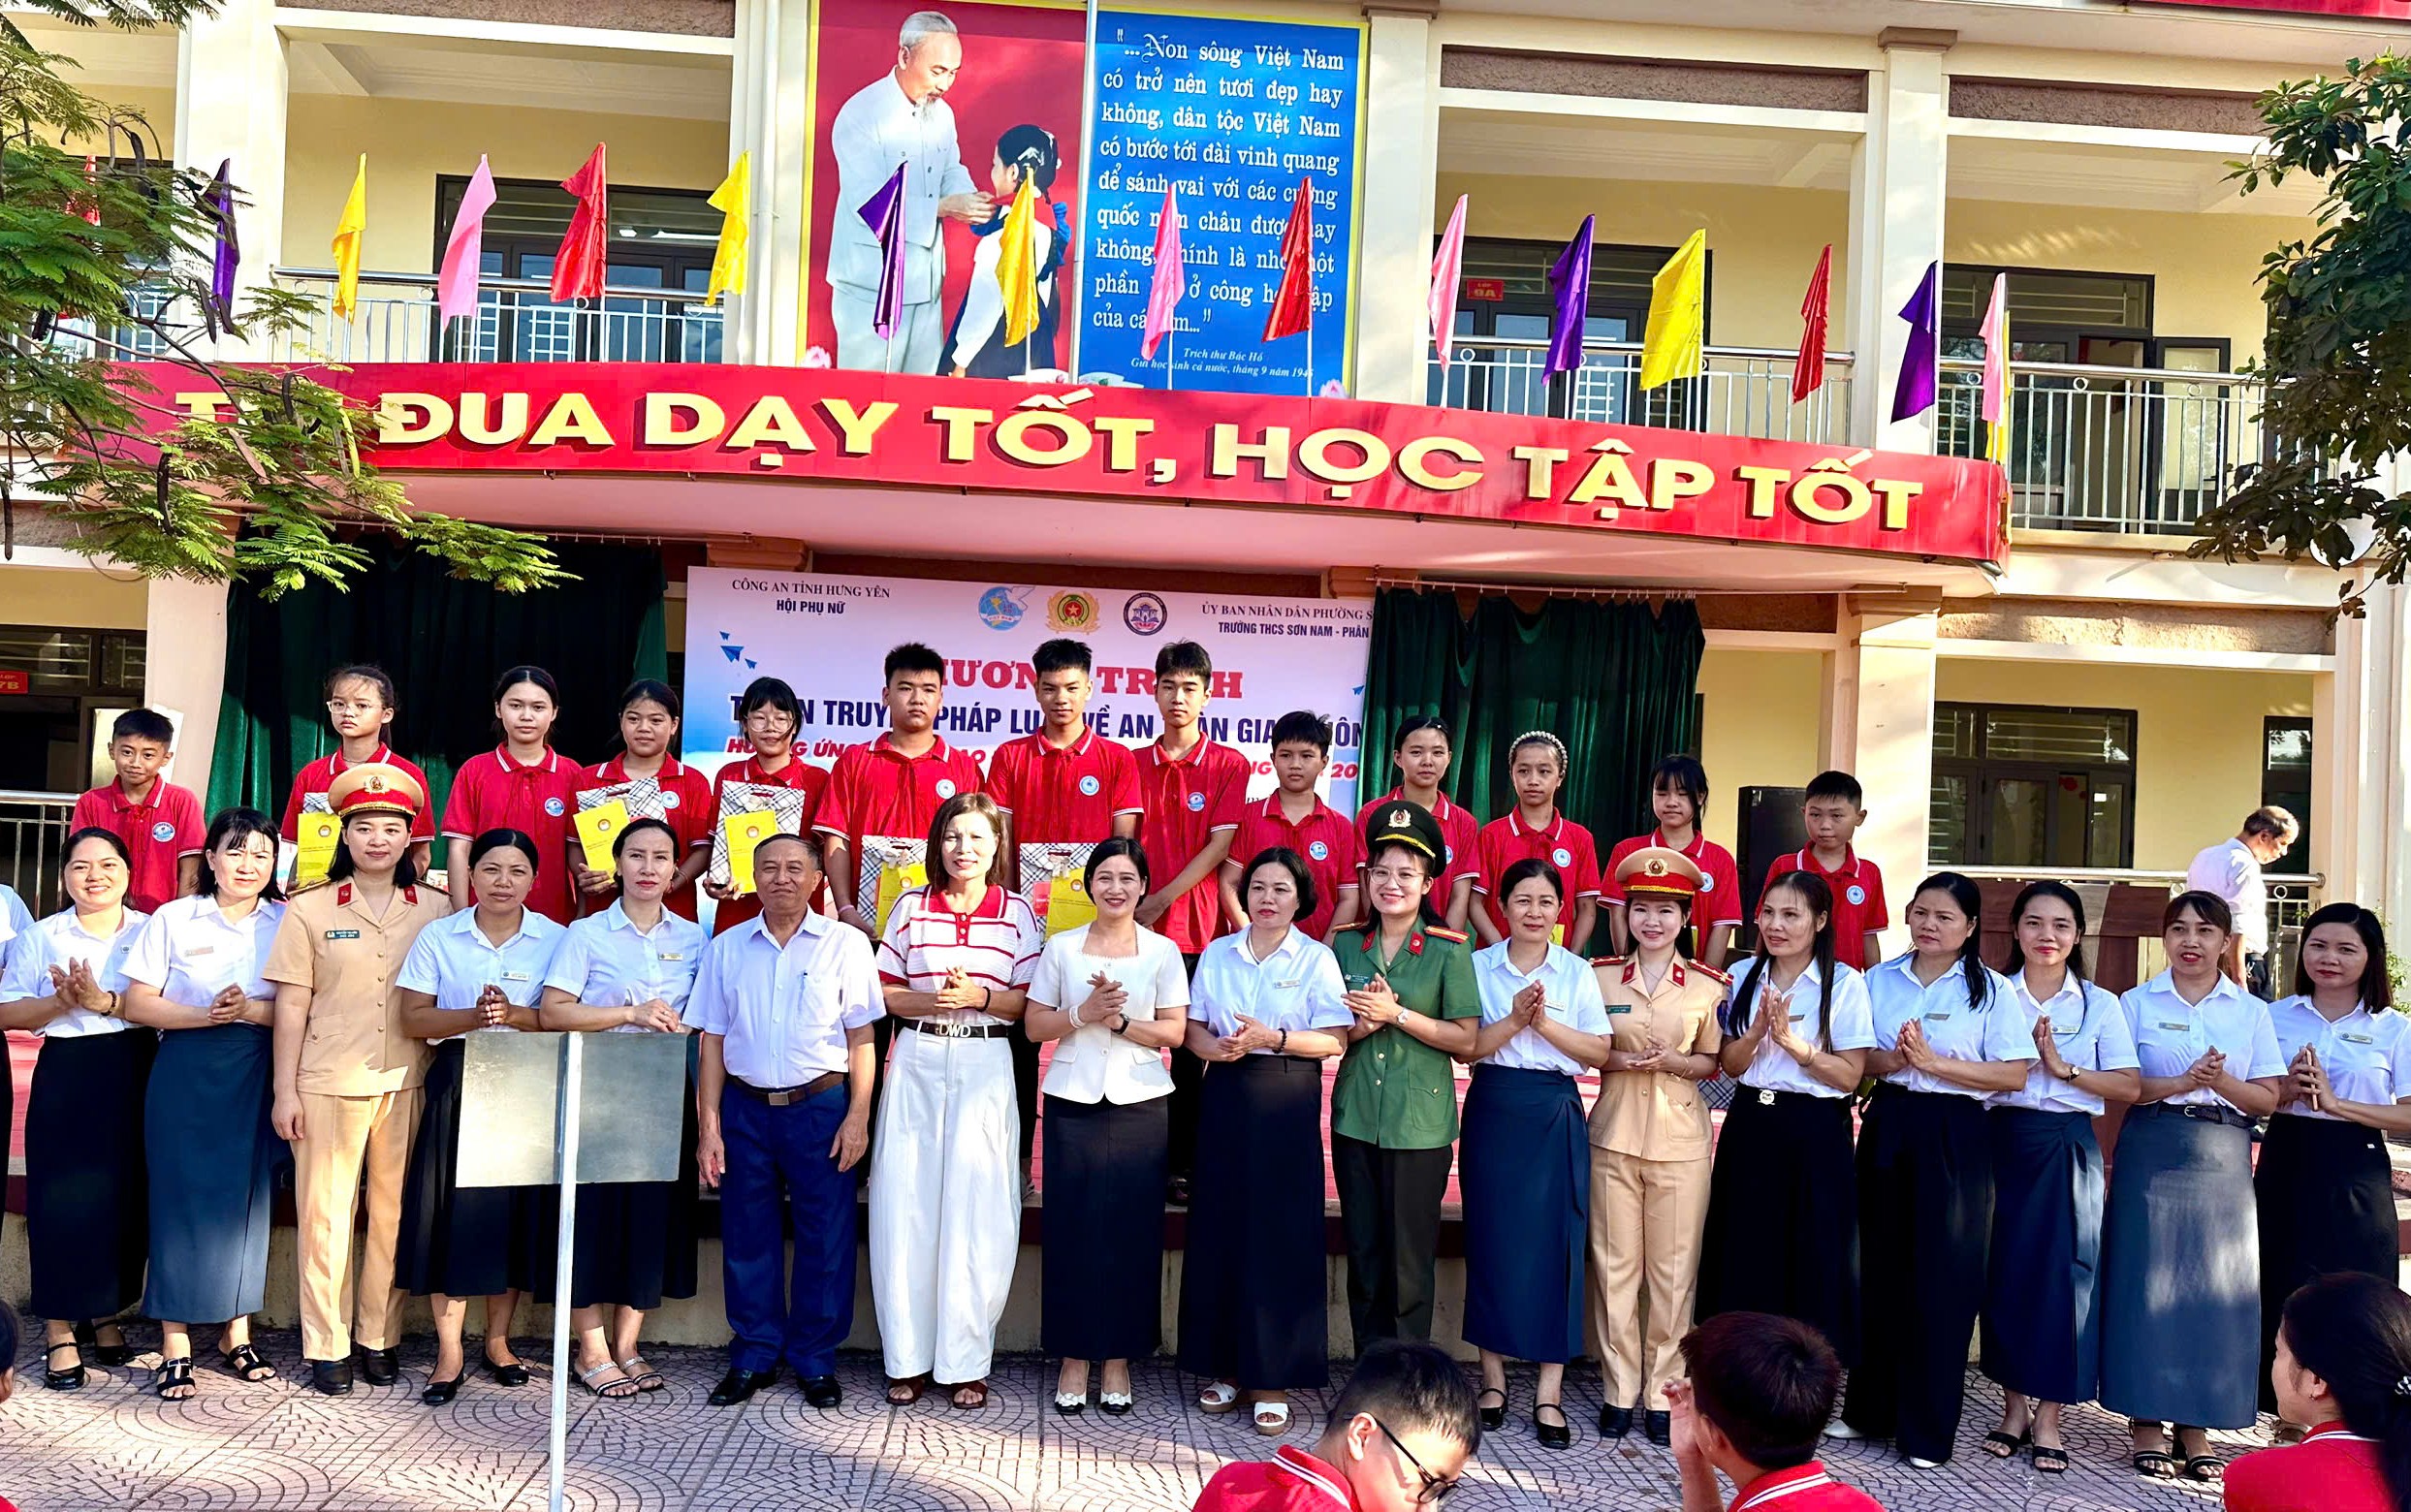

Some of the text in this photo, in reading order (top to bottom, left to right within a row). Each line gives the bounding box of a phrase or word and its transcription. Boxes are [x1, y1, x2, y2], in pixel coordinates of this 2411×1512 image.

[1199, 41, 1243, 69] sông
[1254, 45, 1292, 72] Việt
[1303, 48, 1345, 71] Nam
[1103, 67, 1344, 109] có trở nên tươi đẹp hay
[1101, 102, 1341, 139] không, dân tộc Việt Nam
[1100, 138, 1340, 176] có bước tới đài vinh quang
[1098, 163, 1122, 190] để
[1126, 171, 1169, 194] sánh
[1176, 175, 1204, 196] vai
[1213, 179, 1240, 199] với
[1247, 179, 1277, 202] các
[1096, 201, 1140, 230] quốc
[1150, 211, 1189, 230] nm
[1198, 210, 1241, 234] châu
[1311, 222, 1337, 244] ay
[1181, 242, 1219, 266] hính
[1229, 246, 1247, 268] là
[1094, 268, 1140, 298] phần
[1189, 272, 1201, 299] ở
[1210, 280, 1253, 307] công
[1312, 285, 1333, 312] ập
[1093, 301, 1124, 329] của
[1129, 307, 1147, 330] cá
[1232, 363, 1259, 378] tháng
[1260, 365, 1268, 376] 9
[1269, 366, 1290, 378] năm
[372, 392, 616, 446] ĐUA
[645, 392, 900, 467] DẠY
[932, 387, 1177, 484] TỐT,
[1212, 422, 1486, 499] HỌC
[1513, 437, 1716, 520] TẬP
[1738, 448, 1924, 530] TỐT
[732, 577, 891, 599] CÔNG AN TỈNH HƯNG YÊN
[777, 597, 846, 615] HỘI PHỤ NỮ
[1202, 601, 1219, 614] ỦY
[1221, 605, 1246, 615] BAN
[1249, 604, 1283, 617] NHÂN
[1285, 605, 1310, 618] DÂN
[1313, 608, 1363, 620] PHƯỜNG
[1219, 619, 1257, 634] TRƯỜNG
[1259, 623, 1285, 635] THCS
[1286, 623, 1308, 636] SƠN
[1310, 625, 1333, 637] NAM
[1342, 625, 1370, 638] PHÂN
[1096, 666, 1244, 699] TRH
[824, 700, 893, 728] TRUY
[934, 702, 1001, 733] PHÁP
[1118, 713, 1154, 740] AN
[1237, 717, 1274, 743] GIA
